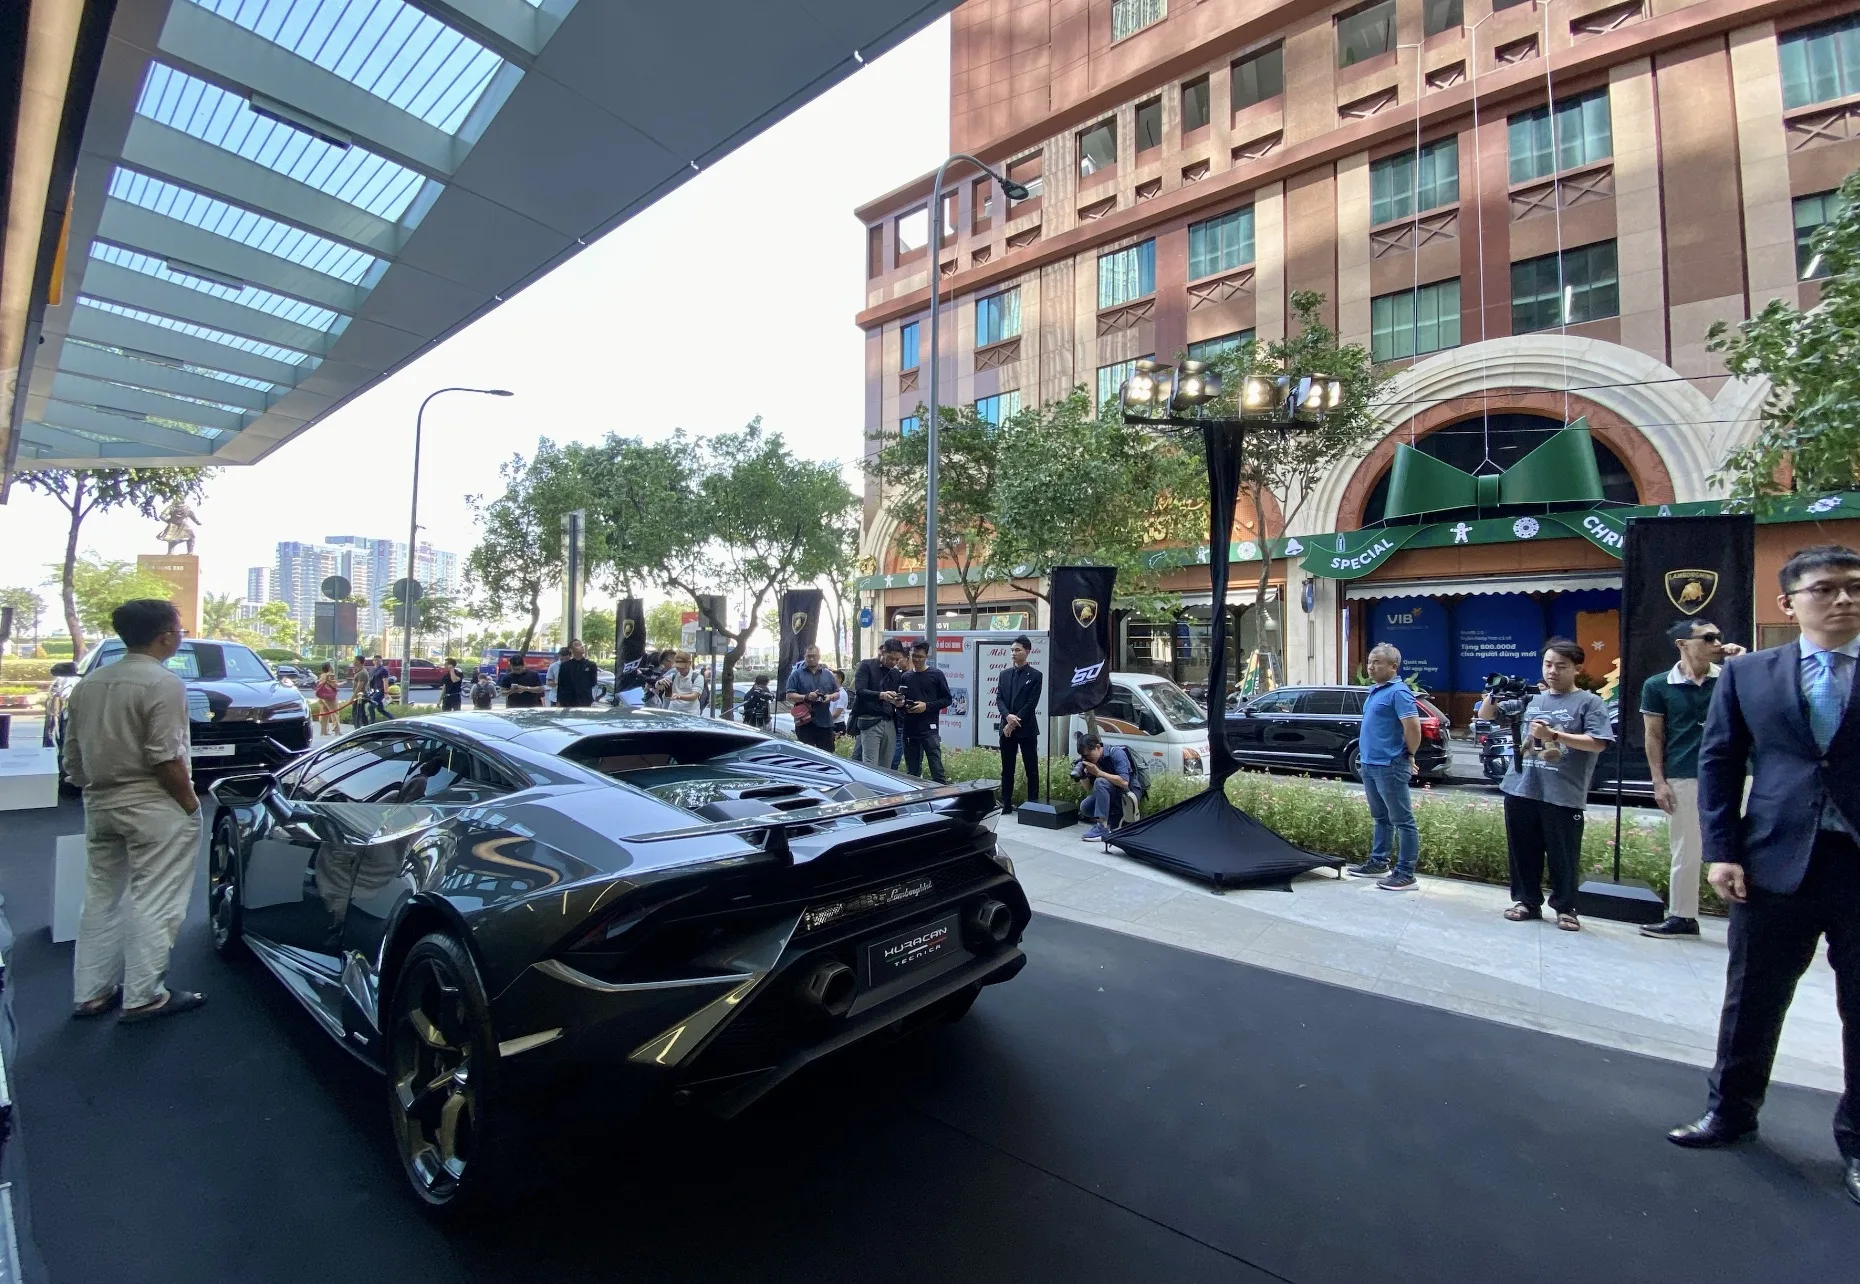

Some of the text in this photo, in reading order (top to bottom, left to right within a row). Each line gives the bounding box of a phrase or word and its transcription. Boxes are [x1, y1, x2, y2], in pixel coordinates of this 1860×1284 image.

[1331, 538, 1394, 570] SPECIAL
[1387, 614, 1413, 624] VIB
[884, 926, 948, 958] HURACAN
